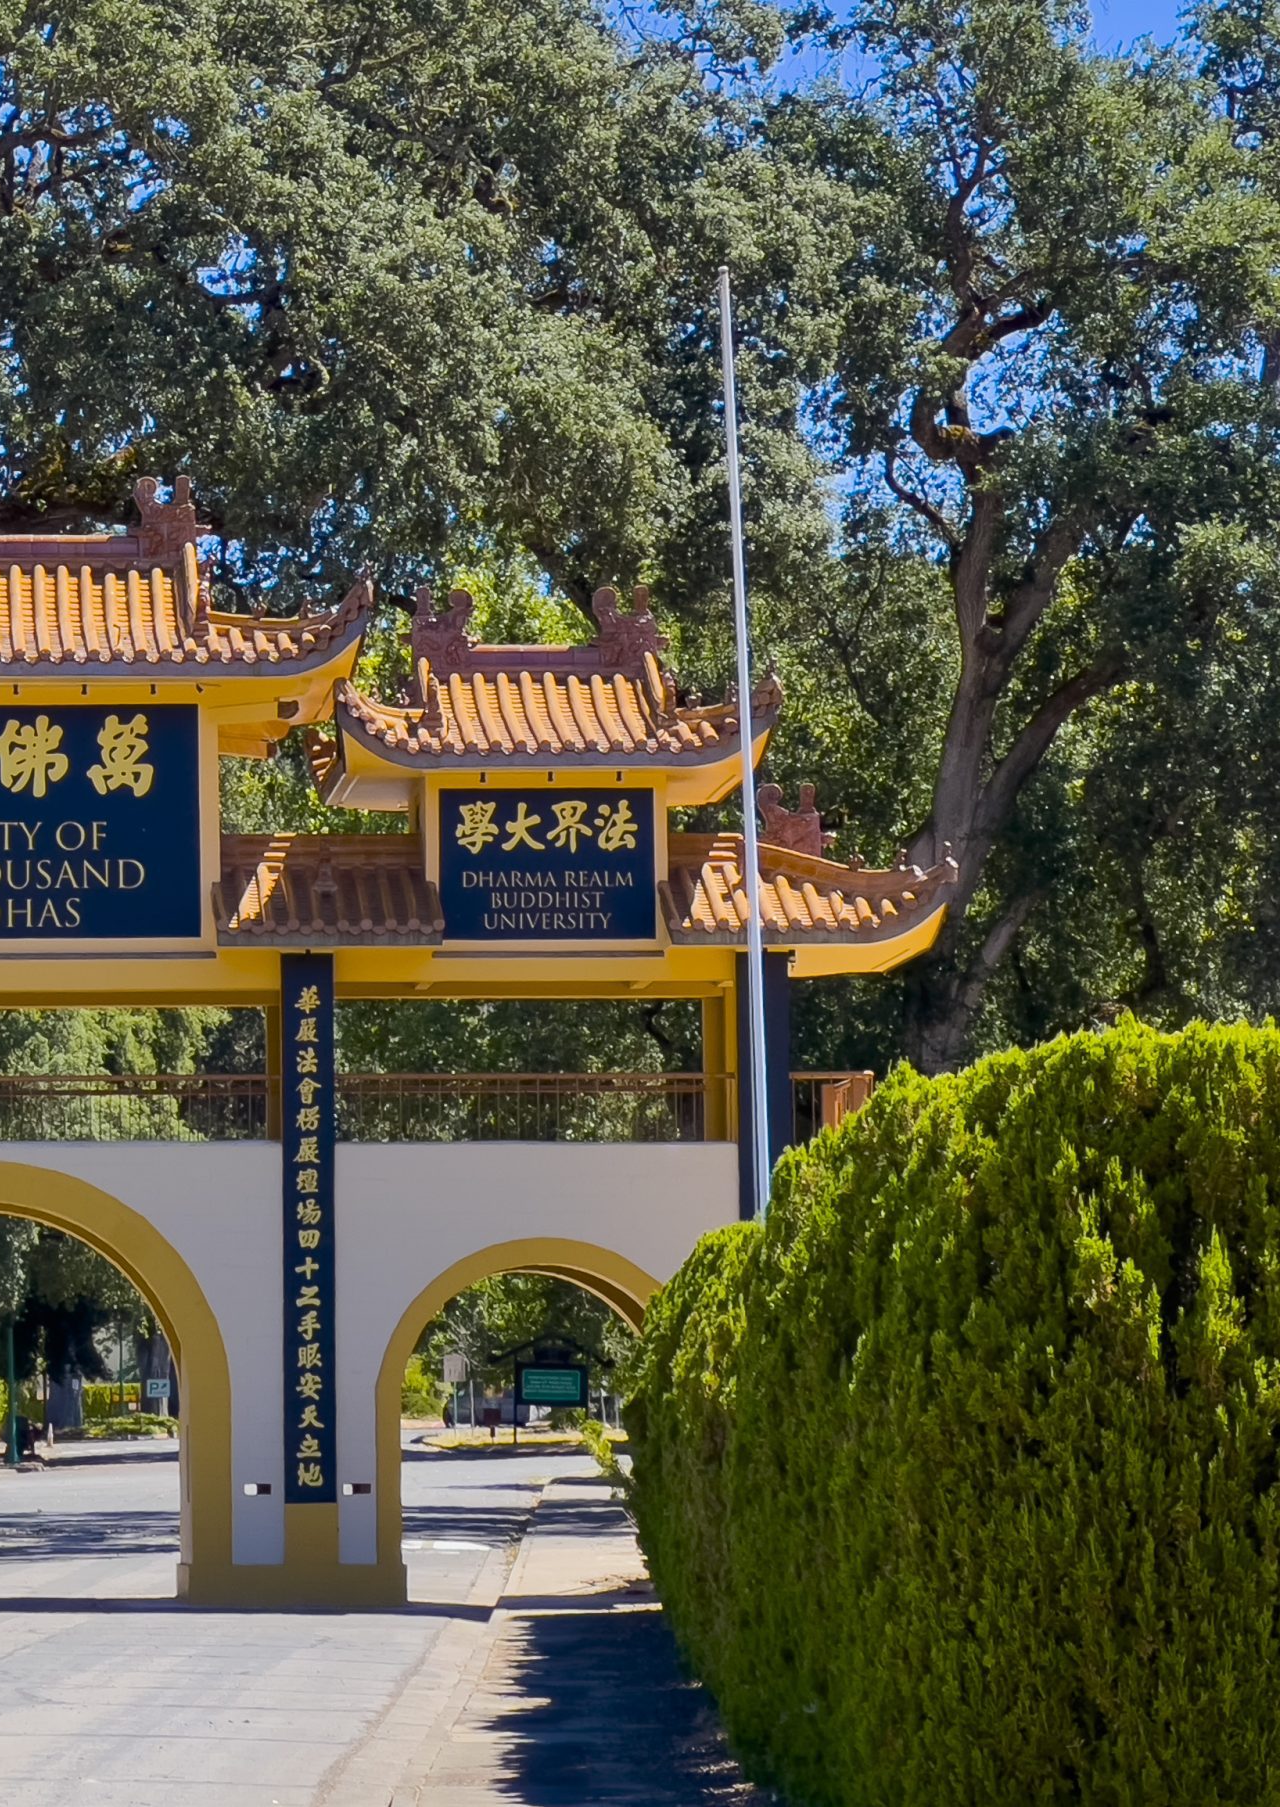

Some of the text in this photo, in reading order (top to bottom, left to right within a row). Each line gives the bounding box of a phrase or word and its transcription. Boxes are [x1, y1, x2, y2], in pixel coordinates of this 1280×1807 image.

[55, 821, 108, 851] OF
[462, 870, 634, 888] DHARMA REALM
[491, 891, 605, 909] BUDDHIST
[484, 912, 612, 930] UNIVERSITY
[149, 1382, 159, 1395] P
